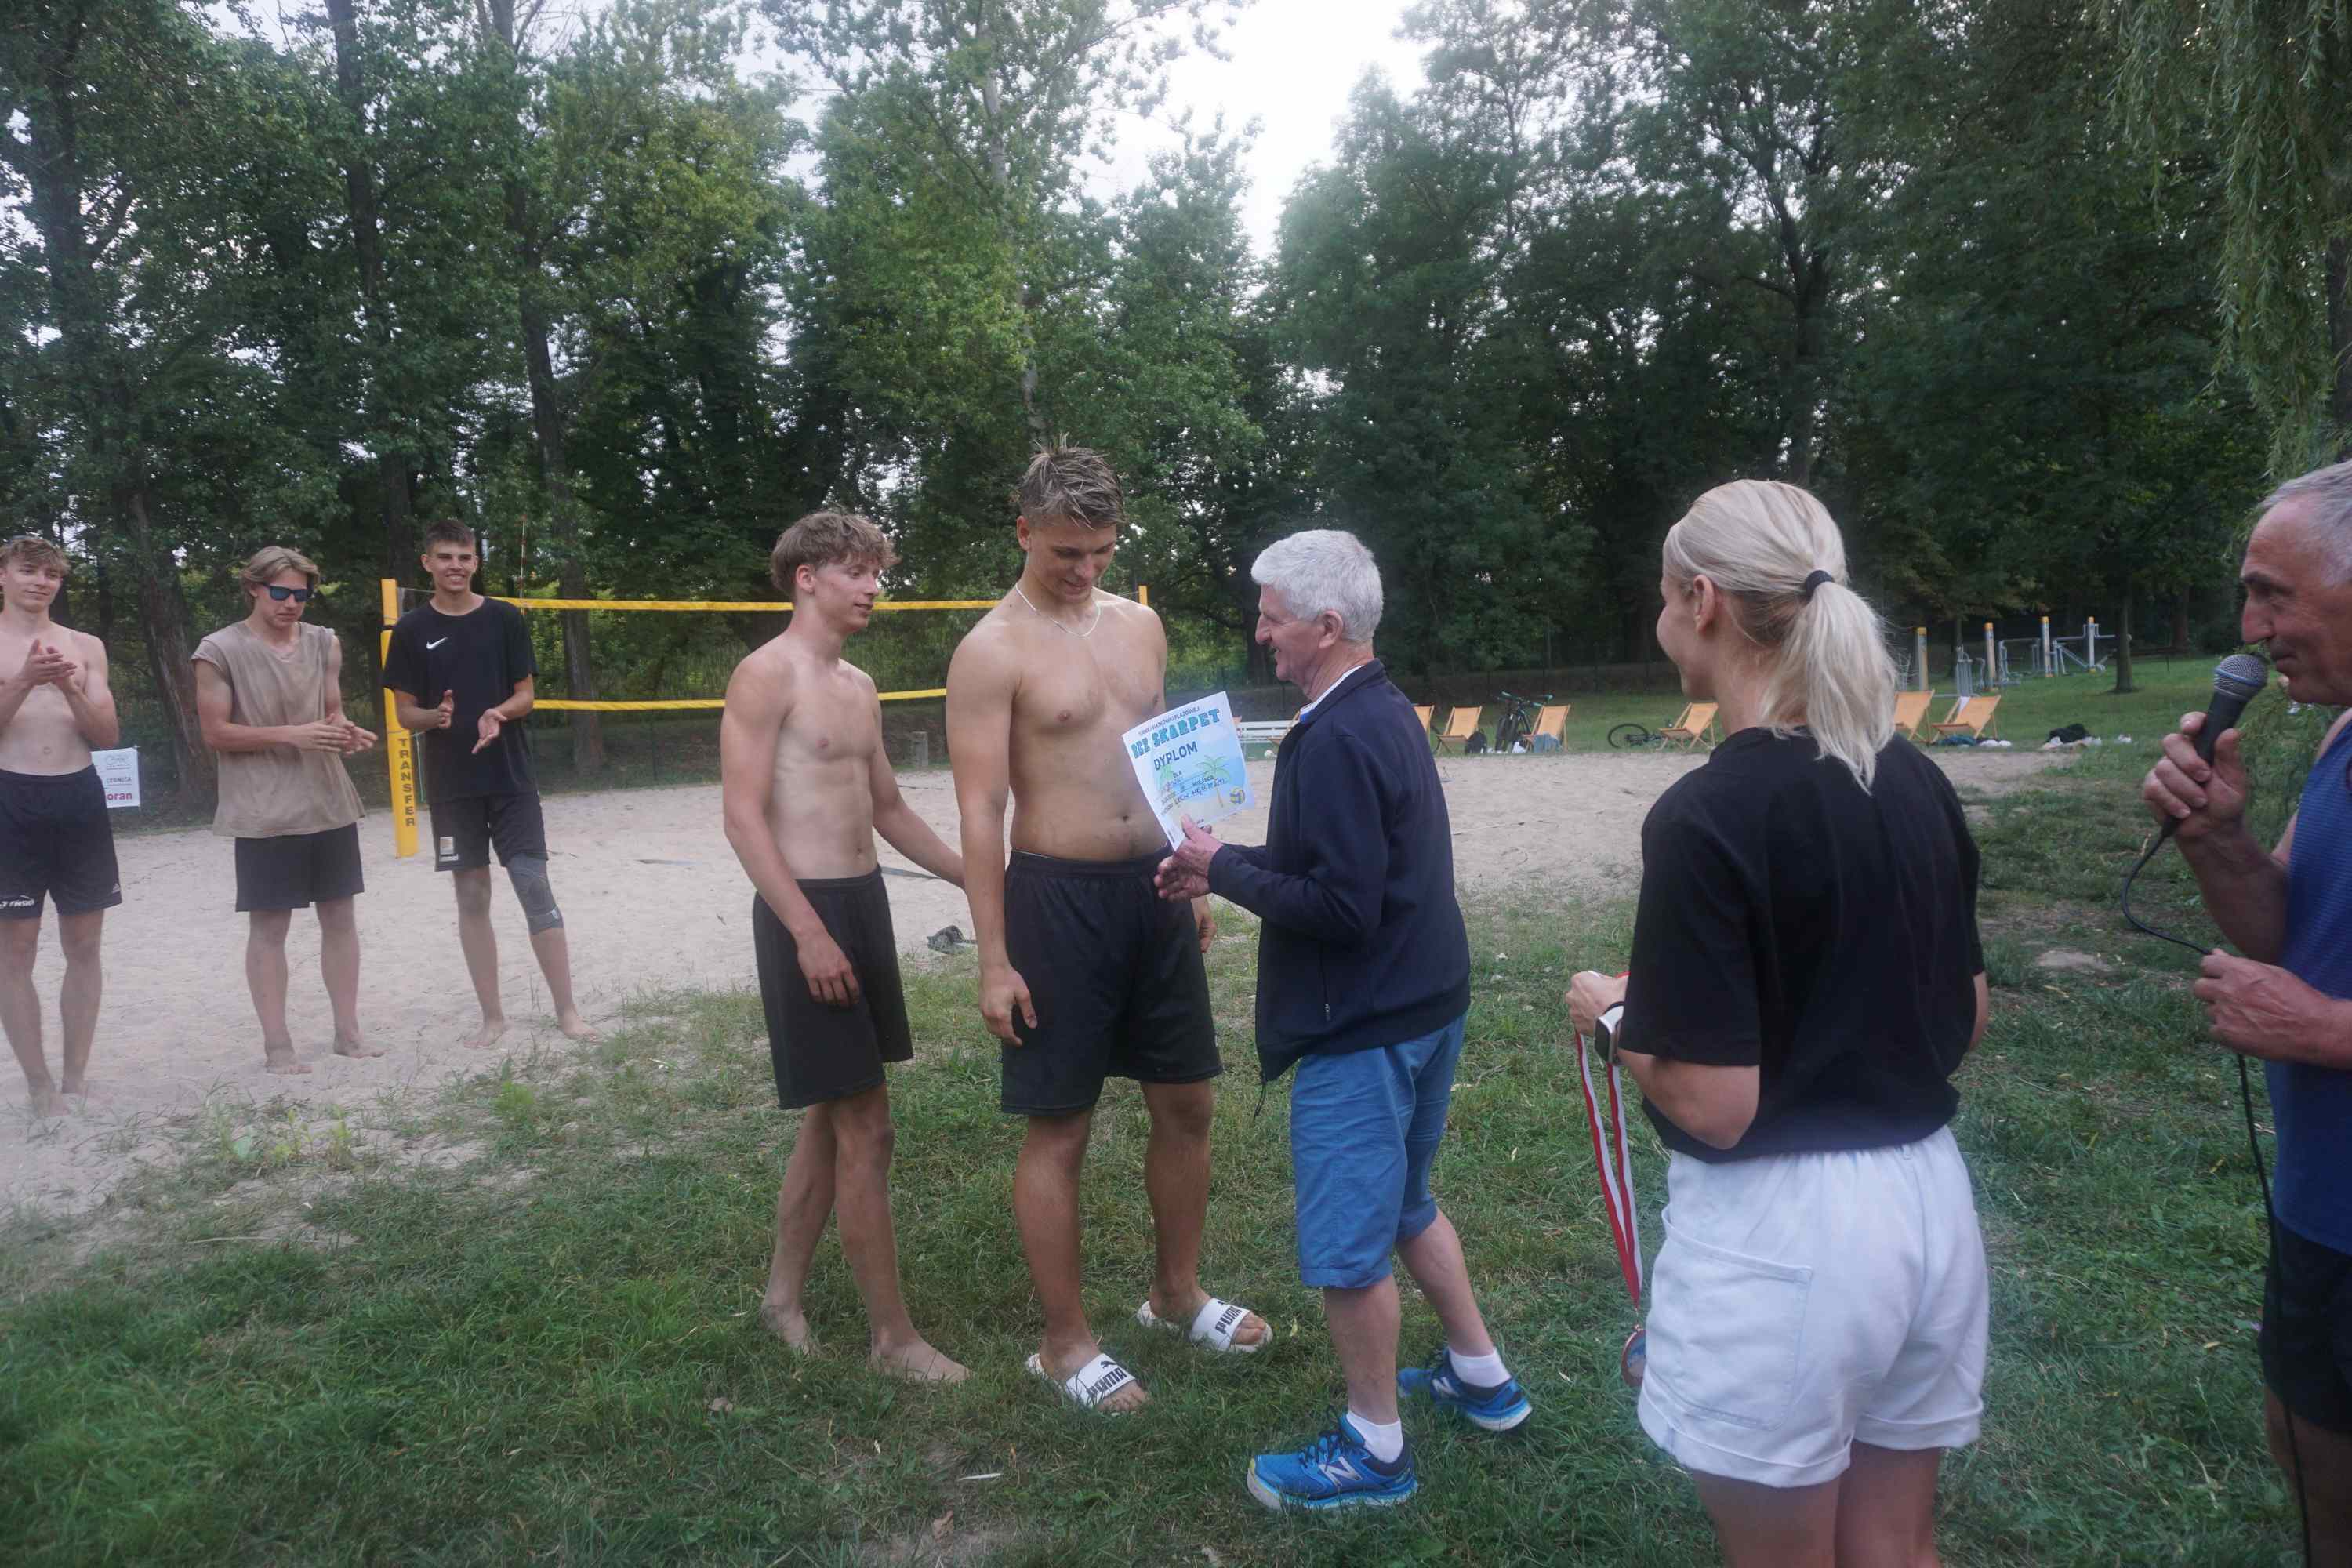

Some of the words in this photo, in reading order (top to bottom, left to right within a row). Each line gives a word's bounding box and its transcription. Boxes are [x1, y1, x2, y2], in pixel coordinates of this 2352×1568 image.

[1131, 737, 1151, 759] BEZ
[1152, 708, 1220, 747] SKARPET
[1153, 741, 1198, 770] DYPLOM
[398, 738, 416, 827] TRANSFER
[1216, 1305, 1243, 1334] PUMA
[1088, 1367, 1127, 1398] PUMA
